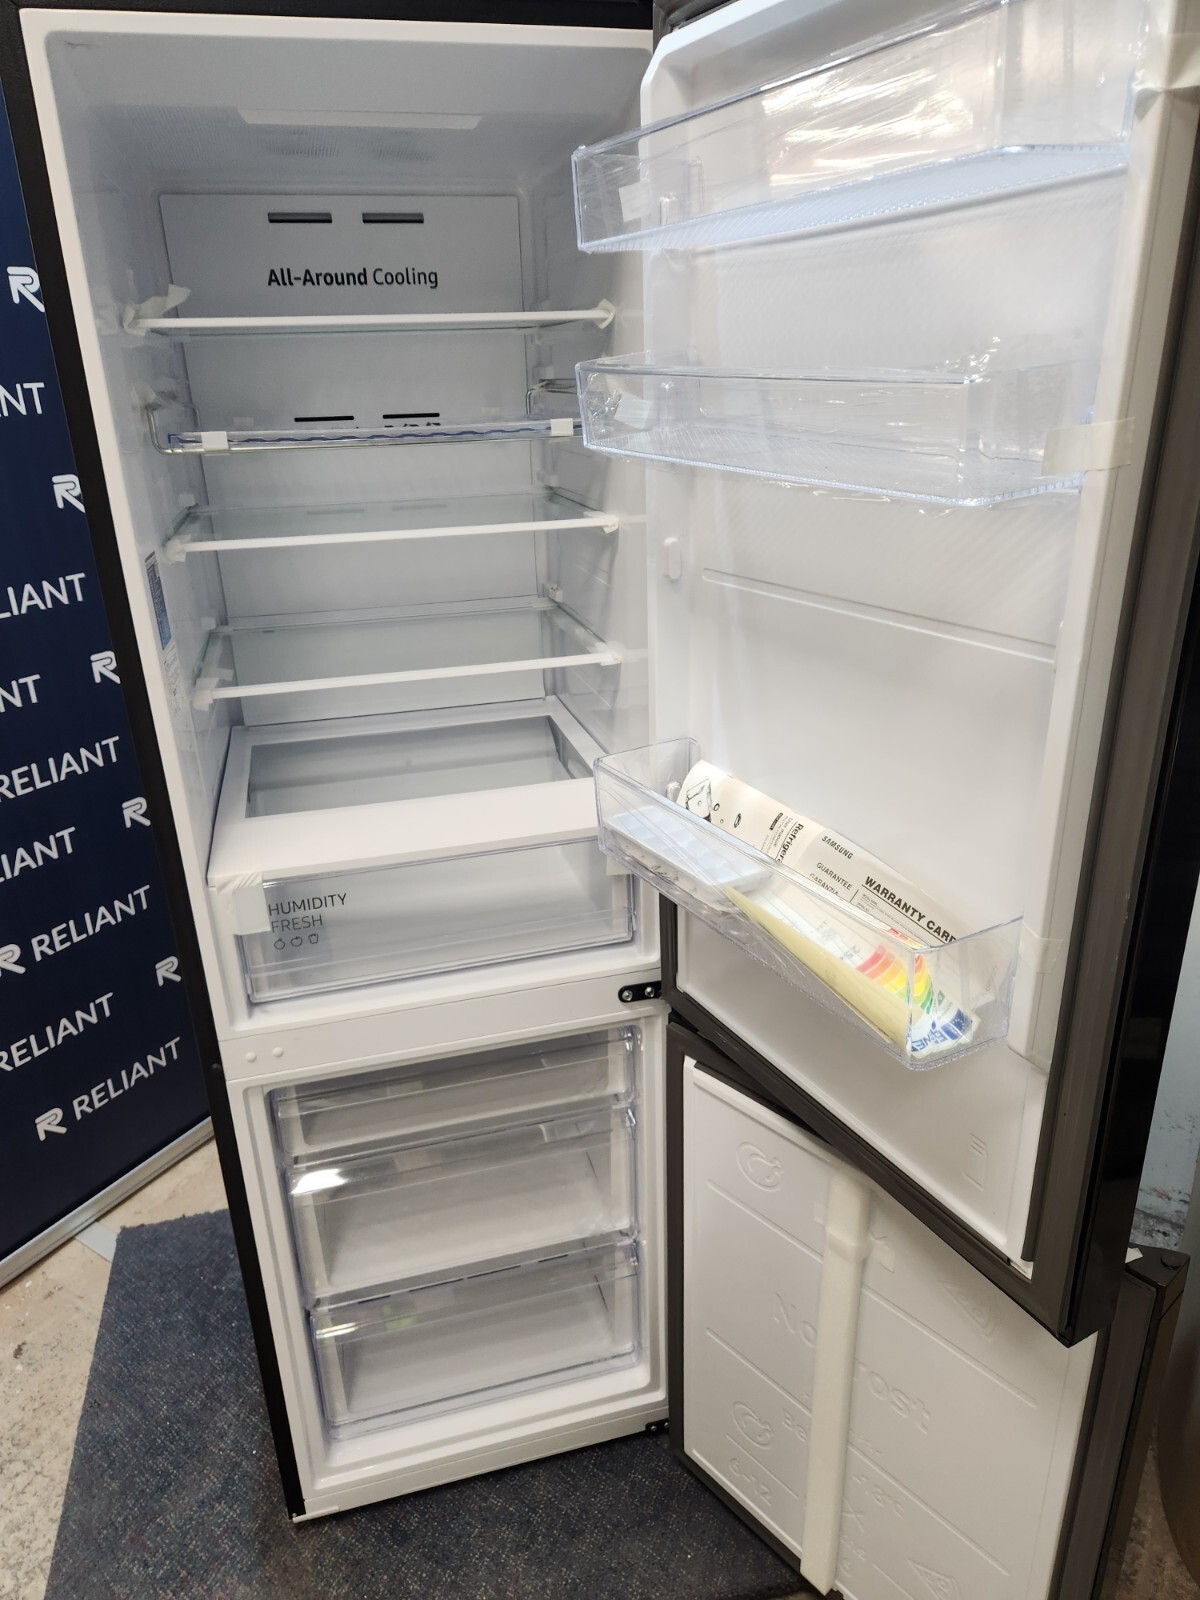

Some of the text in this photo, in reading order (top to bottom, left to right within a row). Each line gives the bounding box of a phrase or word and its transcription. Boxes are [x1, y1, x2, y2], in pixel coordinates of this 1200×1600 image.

[267, 266, 438, 290] All-Around Cooling
[821, 835, 853, 860] SAMSUNG
[816, 862, 852, 891] GUARANTEE
[268, 892, 347, 917] HUMIDITY
[865, 876, 926, 922] WARRANTY
[31, 884, 150, 962] RELIANT
[271, 914, 323, 933] FRESH
[72, 1036, 181, 1121] RELIANT
